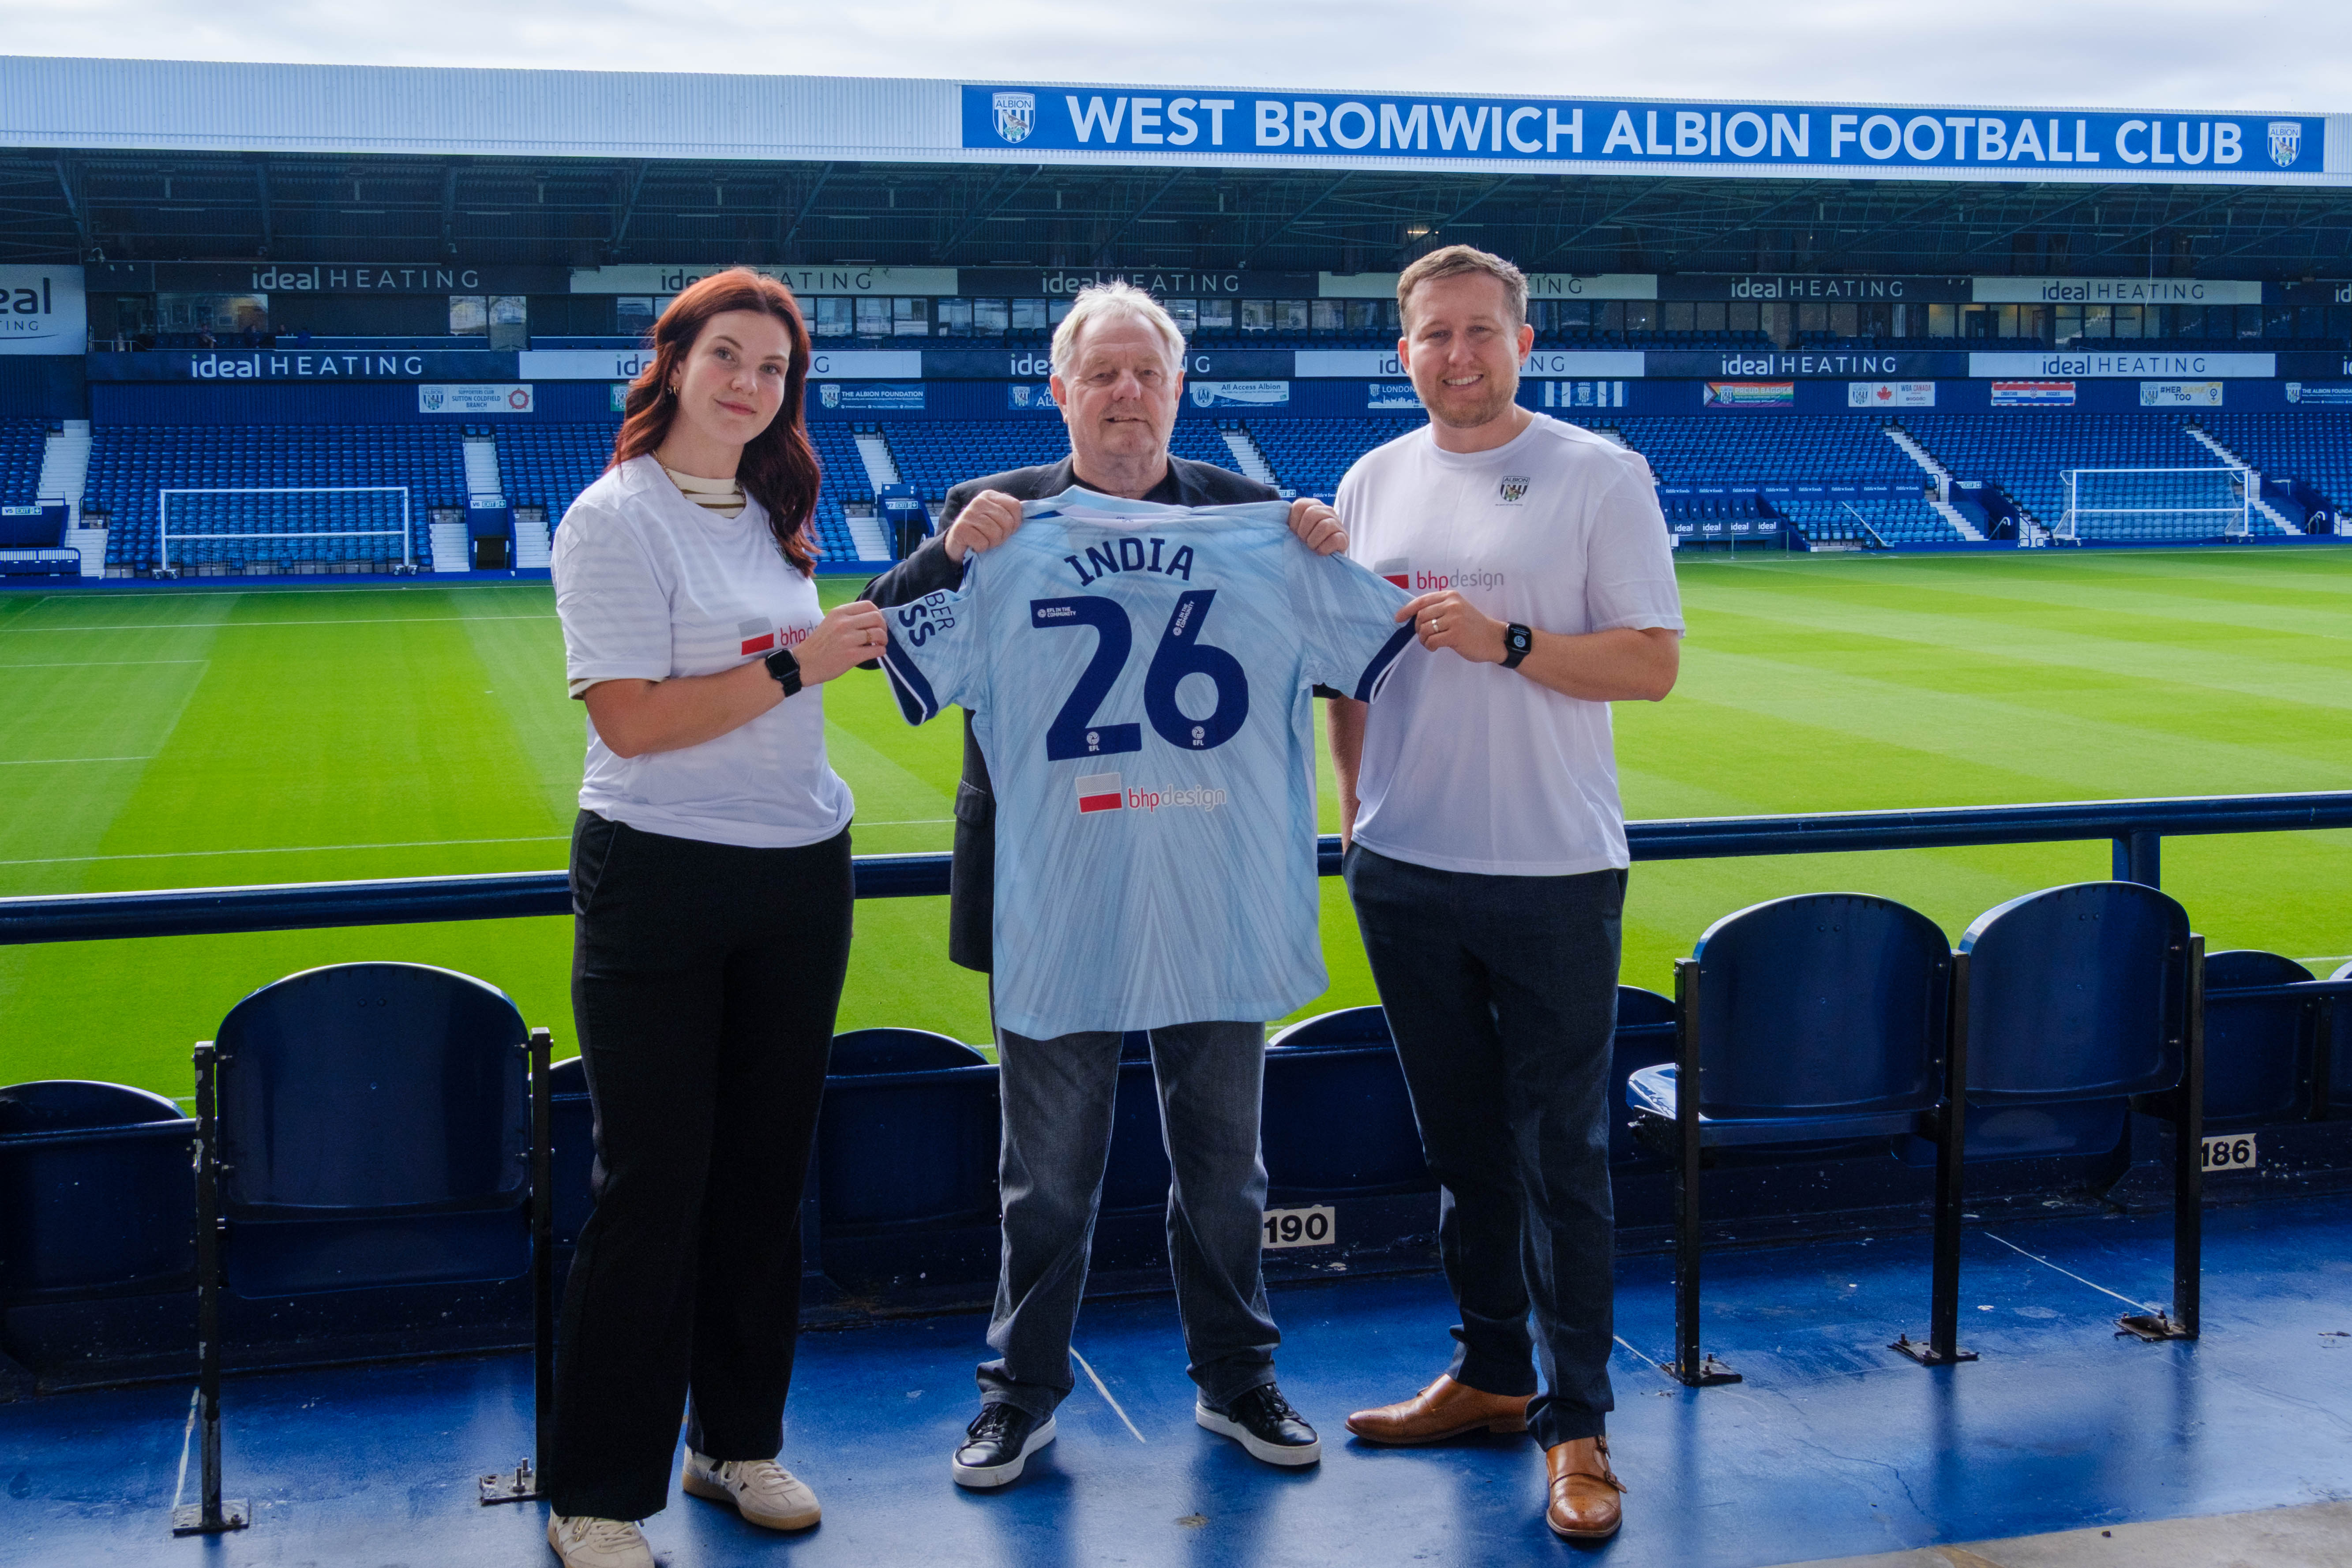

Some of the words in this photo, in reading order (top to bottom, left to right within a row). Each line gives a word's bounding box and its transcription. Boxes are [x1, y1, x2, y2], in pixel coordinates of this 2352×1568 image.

[1066, 95, 1235, 145] WEST
[1256, 100, 1583, 154] BROMWICH
[1602, 110, 1810, 157] ALBION
[1830, 114, 2100, 162] FOOTBALL
[2116, 120, 2242, 165] CLUB
[253, 266, 319, 289] ideal
[331, 269, 479, 288] HEATING
[1731, 278, 1782, 297] ideal
[1790, 280, 1903, 296] HEATING
[2043, 281, 2089, 300] ideal
[2098, 284, 2204, 299] HEATING
[192, 354, 260, 378] ideal
[272, 355, 422, 376] HEATING
[1722, 354, 1773, 375] ideal
[1782, 357, 1896, 373] HEATING
[2043, 356, 2089, 374] ideal
[2099, 357, 2205, 372] HEATING
[1064, 537, 1194, 586] INDIA
[1417, 569, 1504, 592] bhpdesign
[899, 604, 935, 647] SS
[925, 592, 955, 631] BER
[1180, 600, 1195, 628] COMMUNITY
[1030, 589, 1249, 761] 26
[1128, 784, 1226, 812] bhpdesign
[2202, 1139, 2250, 1167] 186
[1264, 1213, 1328, 1243] 190
